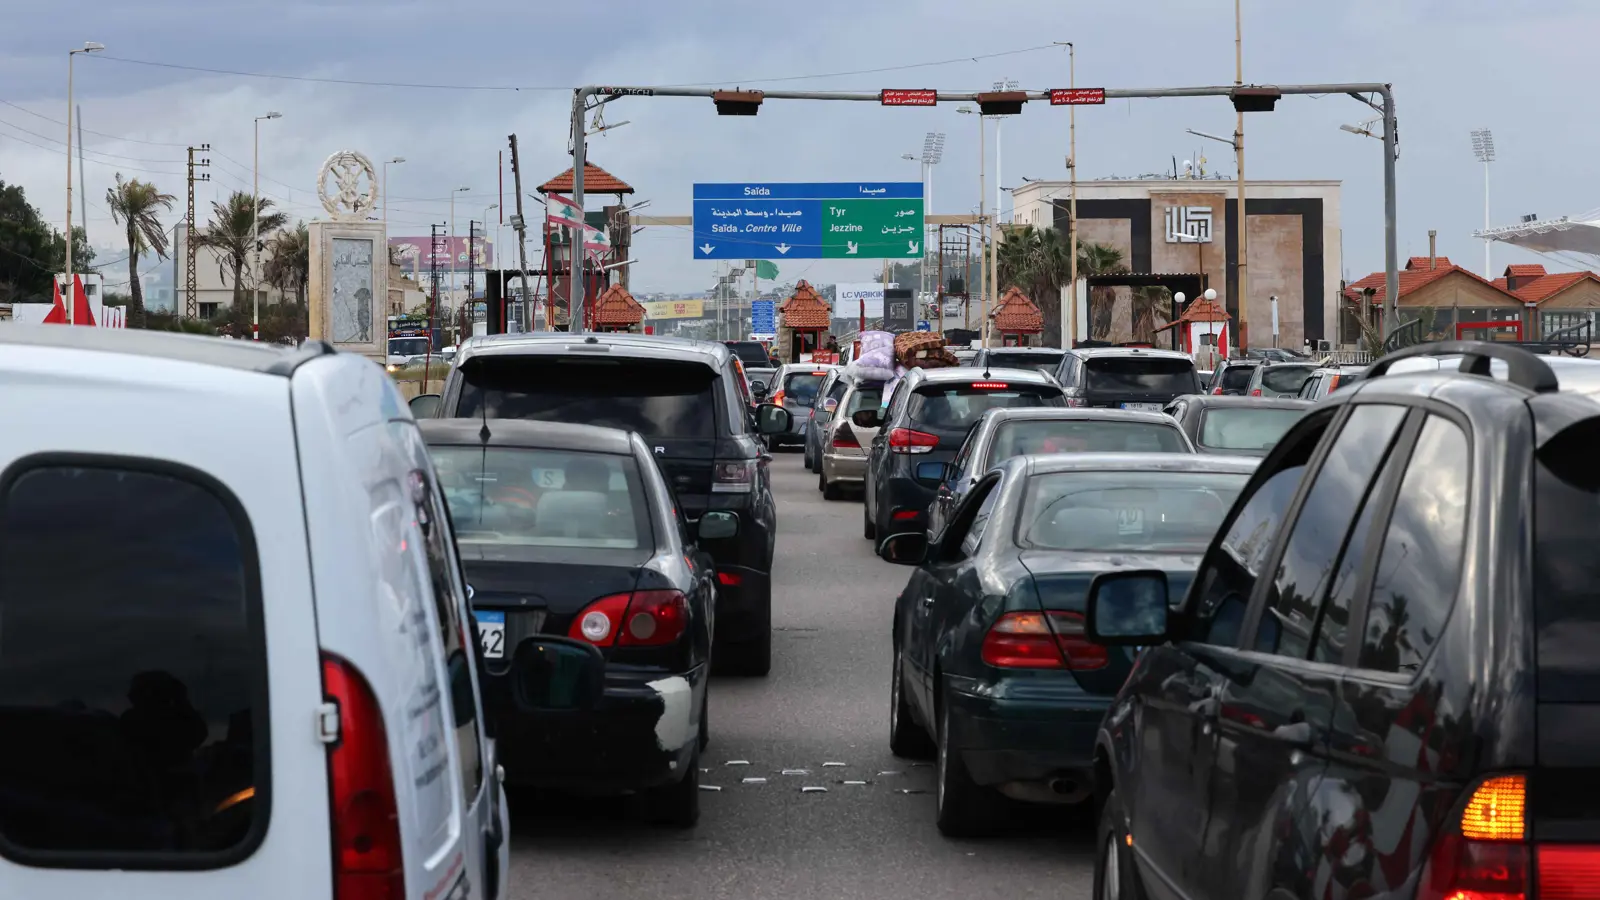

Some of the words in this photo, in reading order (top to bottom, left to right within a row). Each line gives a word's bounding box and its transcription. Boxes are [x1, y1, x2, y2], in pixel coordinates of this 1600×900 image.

[743, 186, 771, 196] Saïda
[859, 185, 887, 196] صيدا
[710, 207, 743, 219] المدينة
[743, 207, 769, 218] وسط
[774, 207, 803, 218] صيدا
[829, 206, 847, 218] Tyr
[894, 208, 916, 218] صور
[711, 223, 738, 233] Saïda
[745, 223, 778, 233] Centre
[781, 223, 803, 233] Ville
[829, 223, 863, 233] Jezzine
[881, 224, 915, 234] جزين
[841, 291, 853, 299] LC
